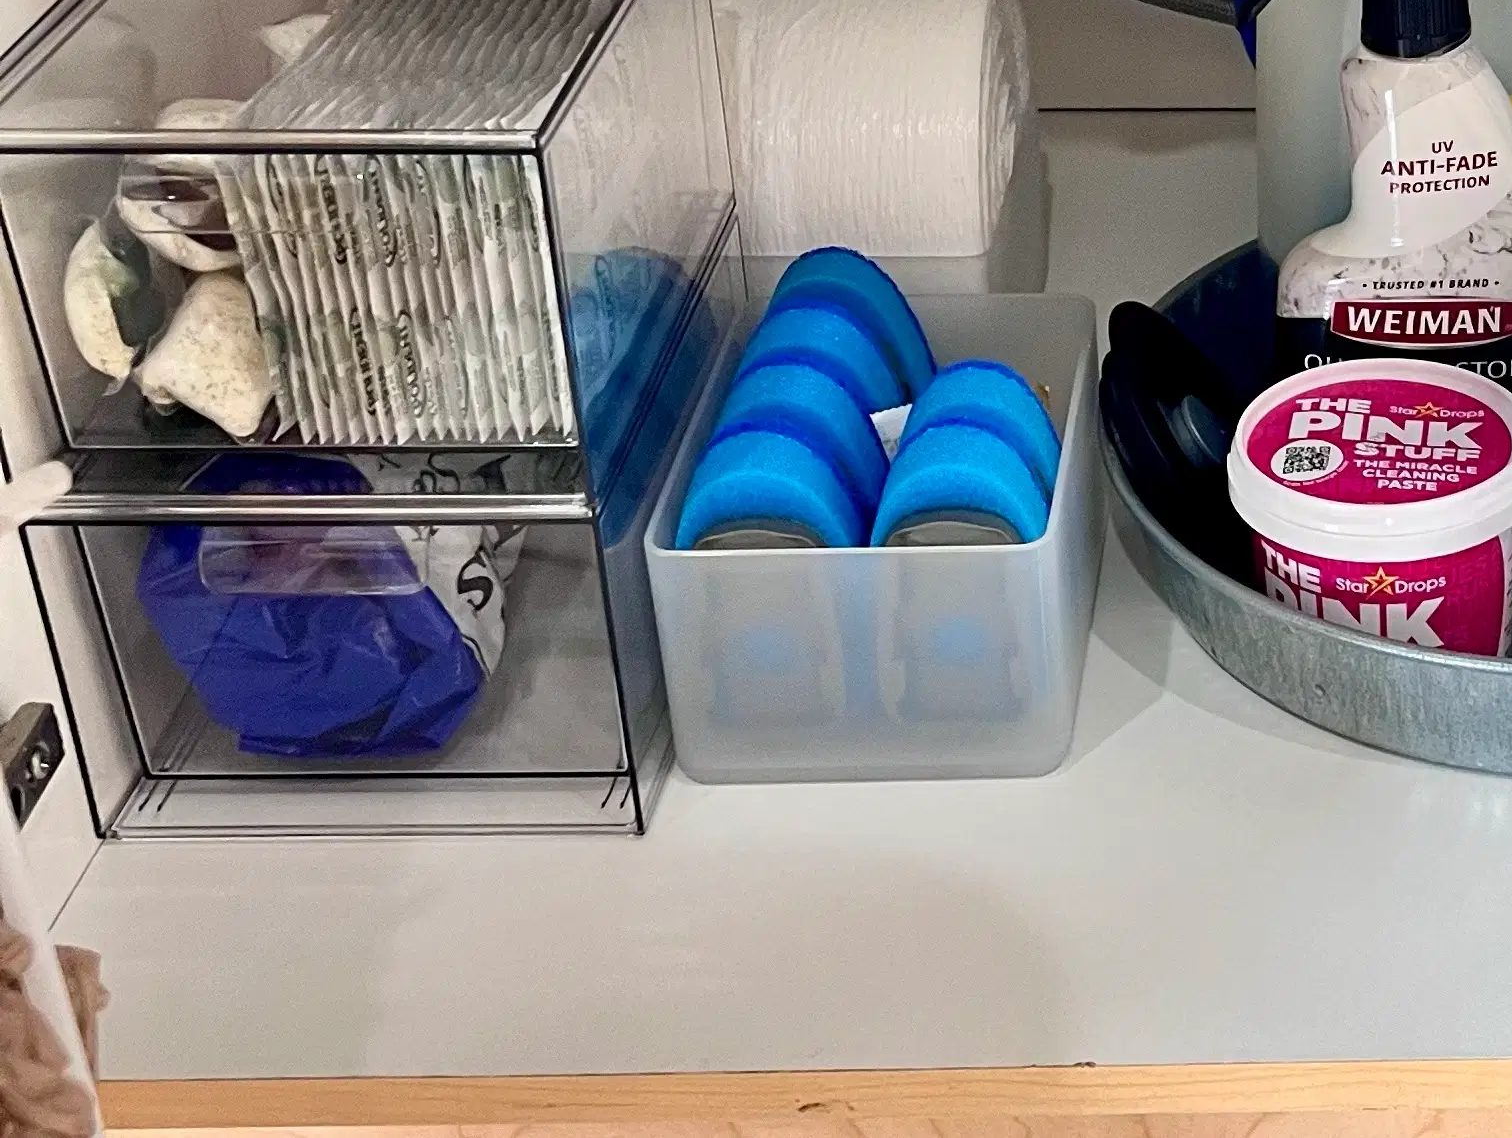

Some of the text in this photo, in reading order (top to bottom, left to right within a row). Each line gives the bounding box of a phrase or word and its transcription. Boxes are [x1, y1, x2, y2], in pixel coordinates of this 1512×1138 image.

[1431, 140, 1454, 154] UV
[1381, 151, 1498, 176] ANTI-FADE
[1389, 175, 1490, 194] PROTECTION
[1372, 278, 1489, 290] TRUSTED #1 BRAND
[1347, 306, 1501, 335] WEIMAN
[1296, 398, 1371, 414] THE
[1288, 411, 1484, 450] PINK
[1353, 441, 1481, 462] STUFF
[1353, 459, 1478, 474] THE MIRACLE
[1362, 468, 1459, 483] CLEANING
[1377, 479, 1437, 492] PASTE
[1261, 539, 1322, 594] THE
